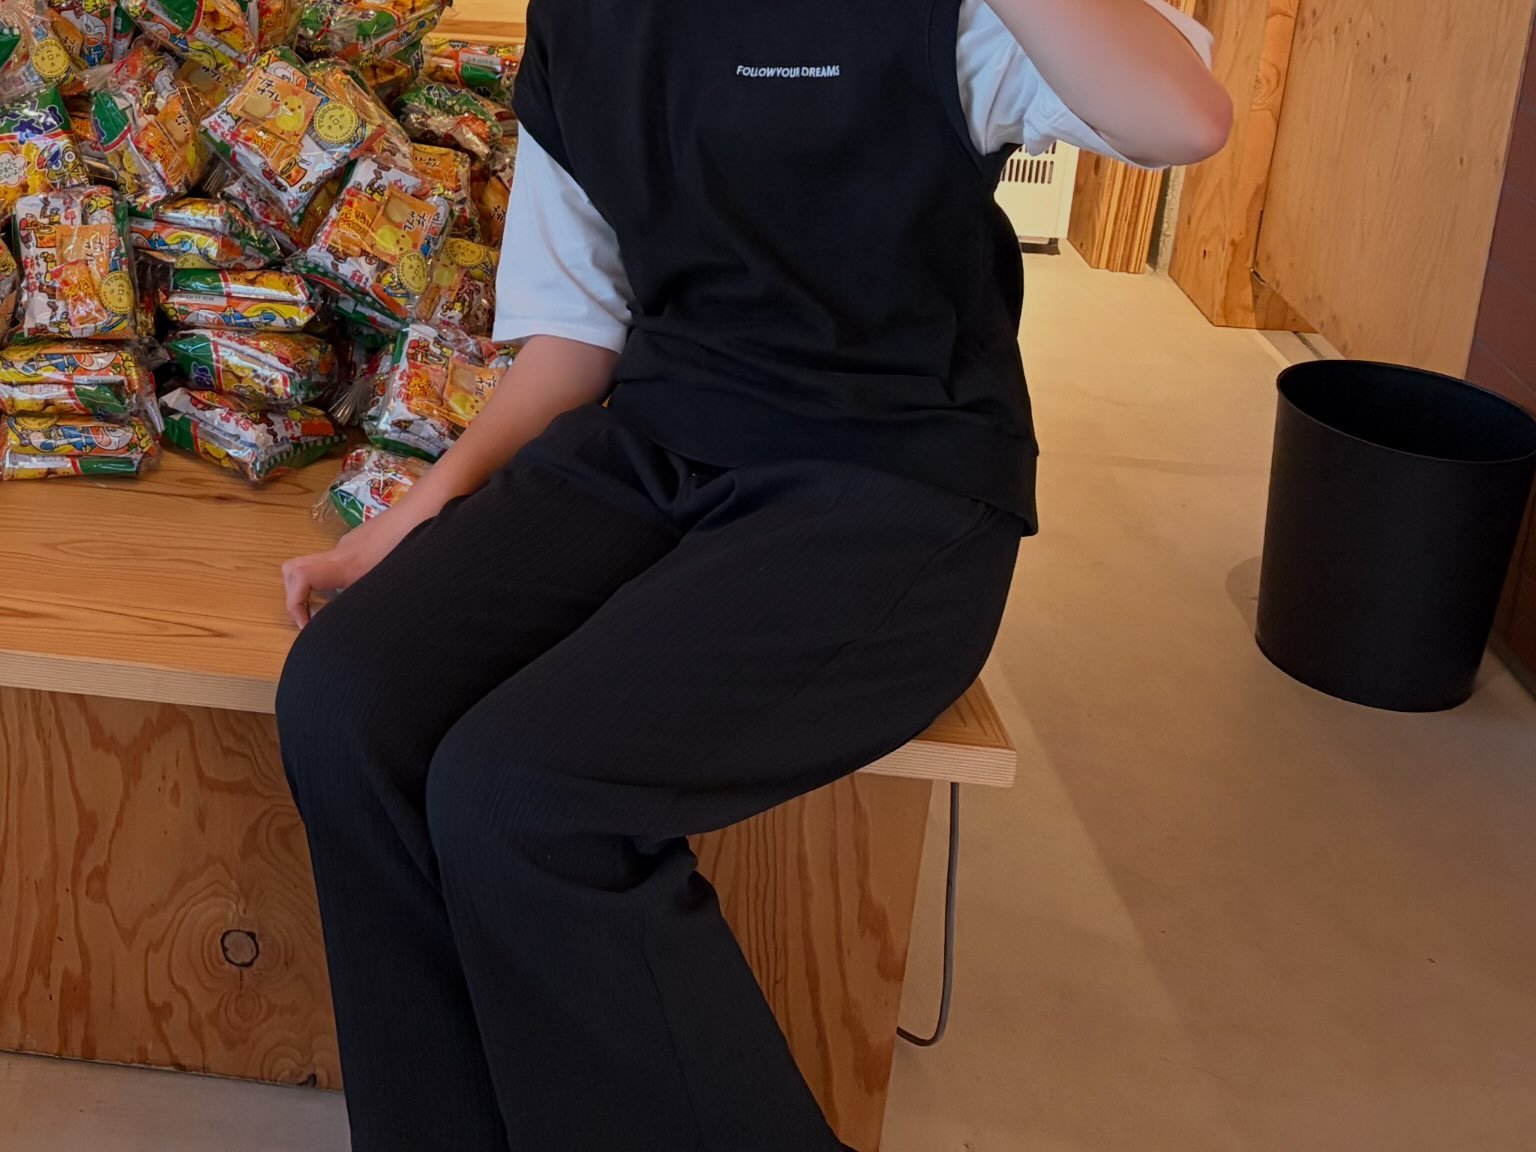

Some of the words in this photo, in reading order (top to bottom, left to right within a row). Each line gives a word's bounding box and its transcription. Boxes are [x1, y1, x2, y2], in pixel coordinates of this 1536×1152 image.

[801, 65, 840, 78] DREAMS
[256, 87, 281, 103] サブレ
